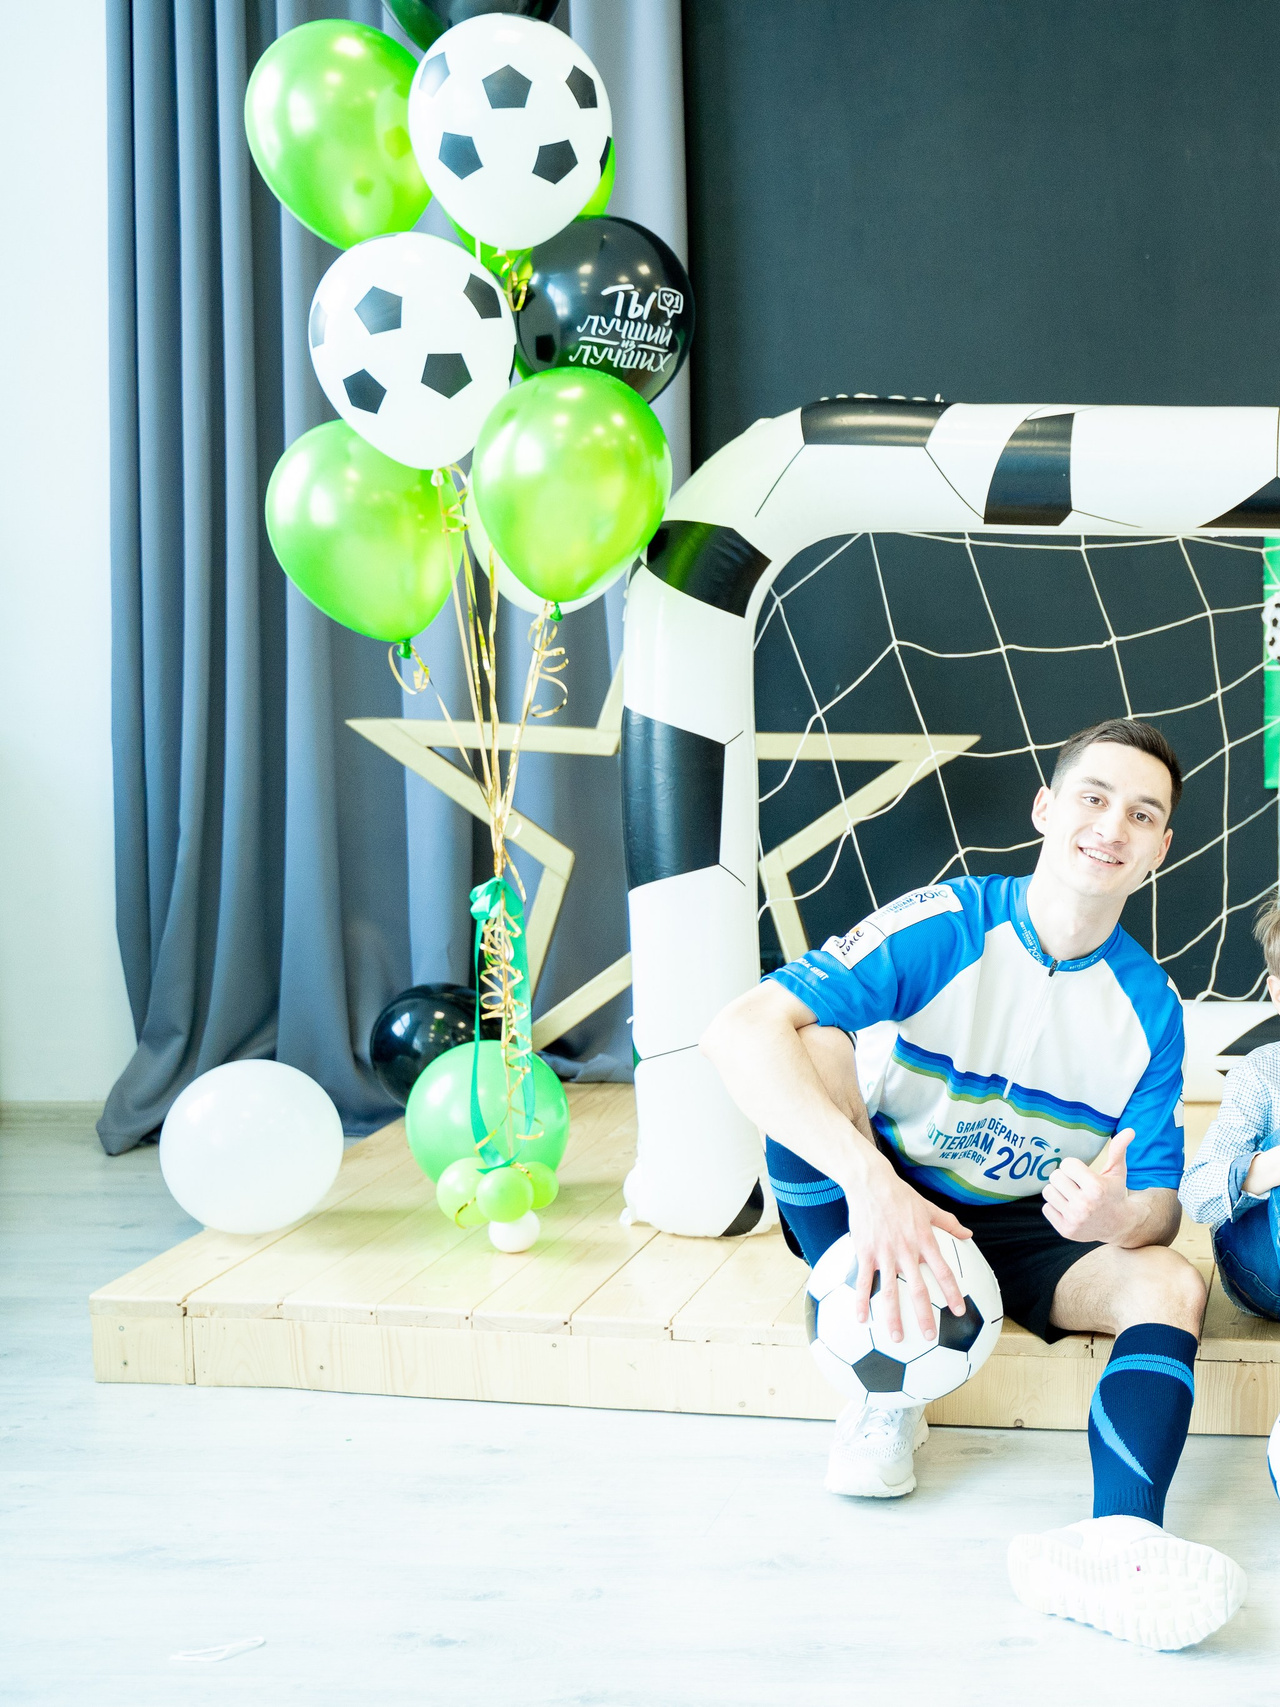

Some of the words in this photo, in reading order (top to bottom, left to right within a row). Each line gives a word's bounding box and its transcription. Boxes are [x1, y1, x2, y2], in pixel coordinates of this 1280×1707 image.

[601, 284, 657, 320] ТЫ
[576, 315, 673, 347] ЛУЧШИЙ
[569, 345, 673, 372] ЛУЧШИХ
[956, 1118, 987, 1134] GRAND
[939, 1151, 959, 1160] NEW
[958, 1150, 986, 1166] ENERGY
